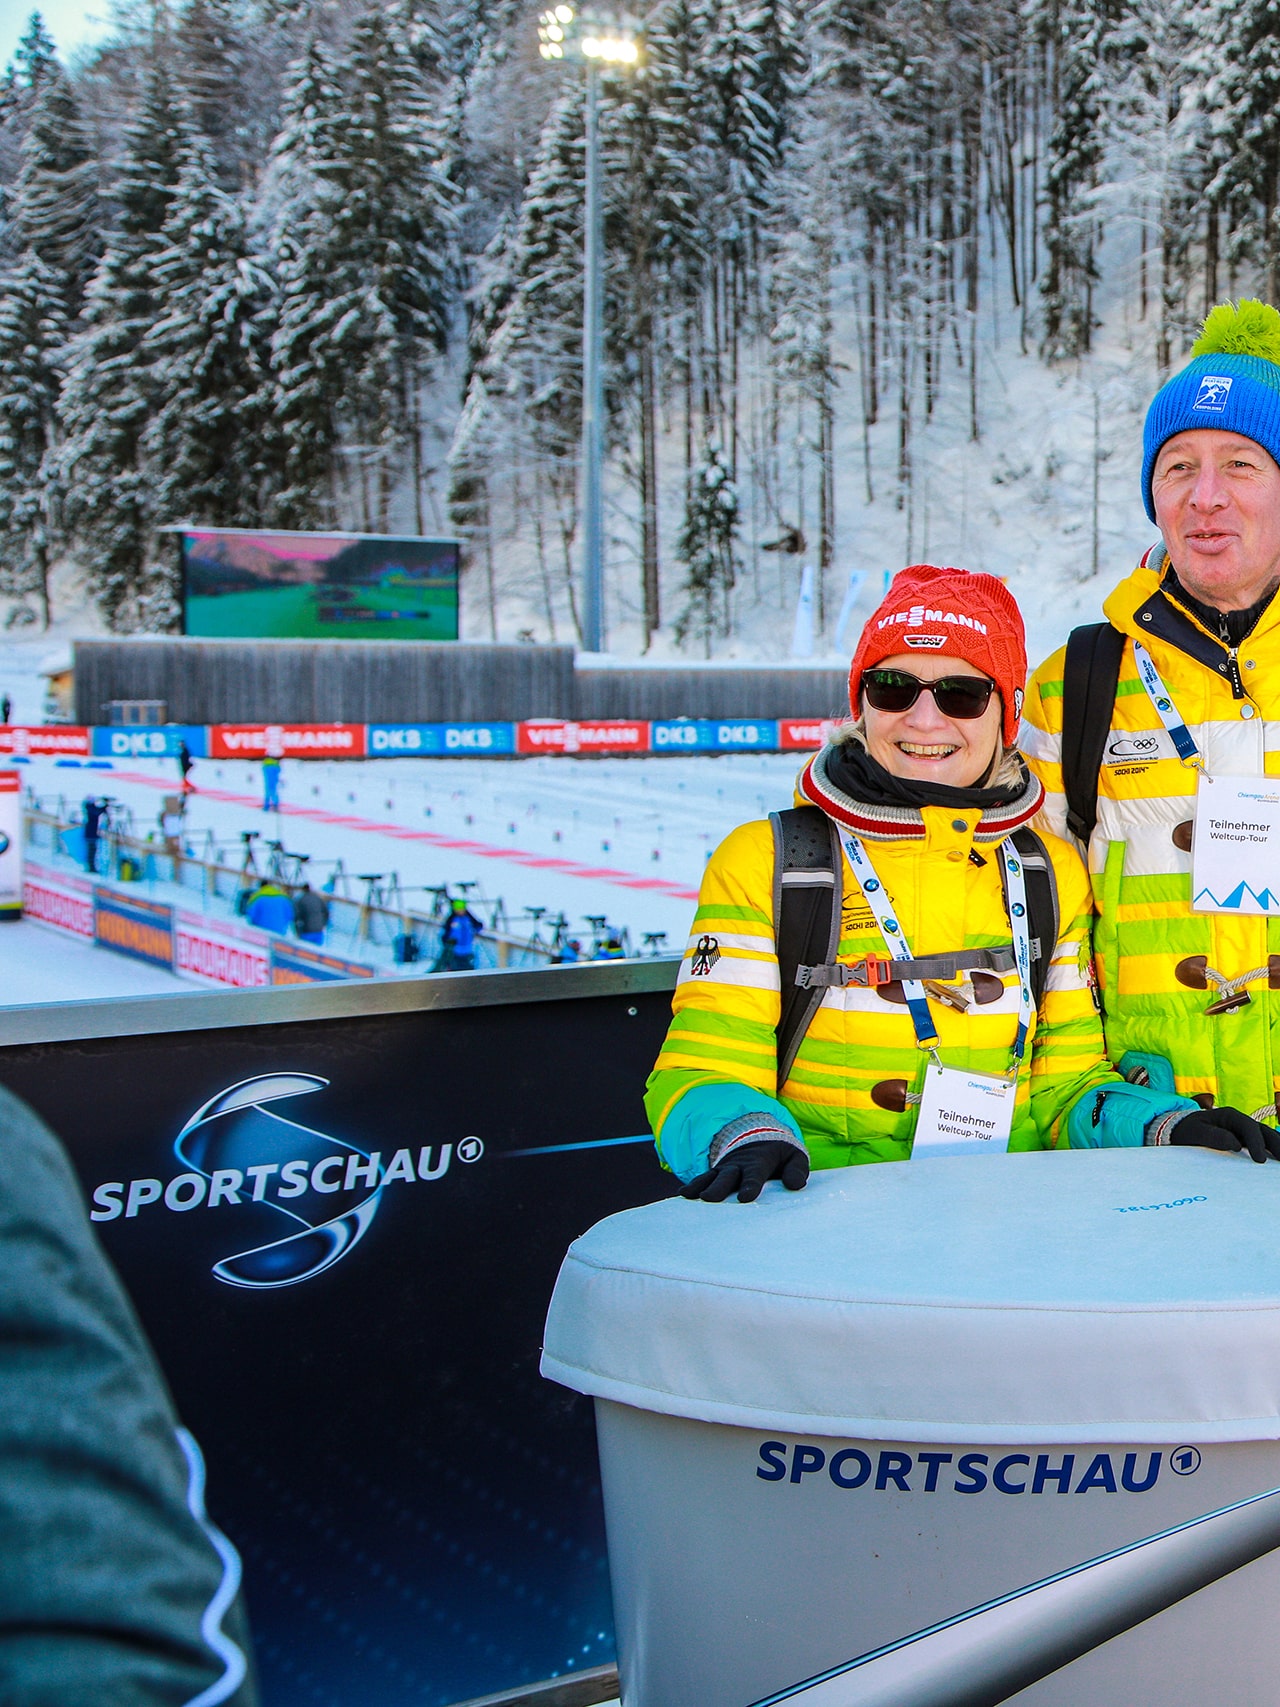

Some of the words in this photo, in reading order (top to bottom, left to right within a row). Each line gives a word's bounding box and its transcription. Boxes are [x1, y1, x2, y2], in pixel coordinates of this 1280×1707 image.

[877, 605, 987, 635] VIESSMANN
[111, 732, 166, 753] DKB
[222, 726, 353, 757] VIESSMANN
[372, 729, 421, 749] DKB
[445, 728, 492, 747] DKB
[527, 723, 639, 752] VIESSMANN
[655, 725, 698, 744] DKB
[718, 725, 759, 743] DKB
[1209, 819, 1271, 832] Teilnehmer
[1210, 832, 1268, 842] Weltcup-Tour
[844, 923, 864, 932] SOCHI
[177, 931, 270, 988] BAUHAUS
[938, 1109, 996, 1129] Teilnehmer
[937, 1123, 992, 1140] Weltcup-Tour
[90, 1143, 453, 1223] SPORTSCHAU
[755, 1440, 1163, 1495] SPORTSCHAU
